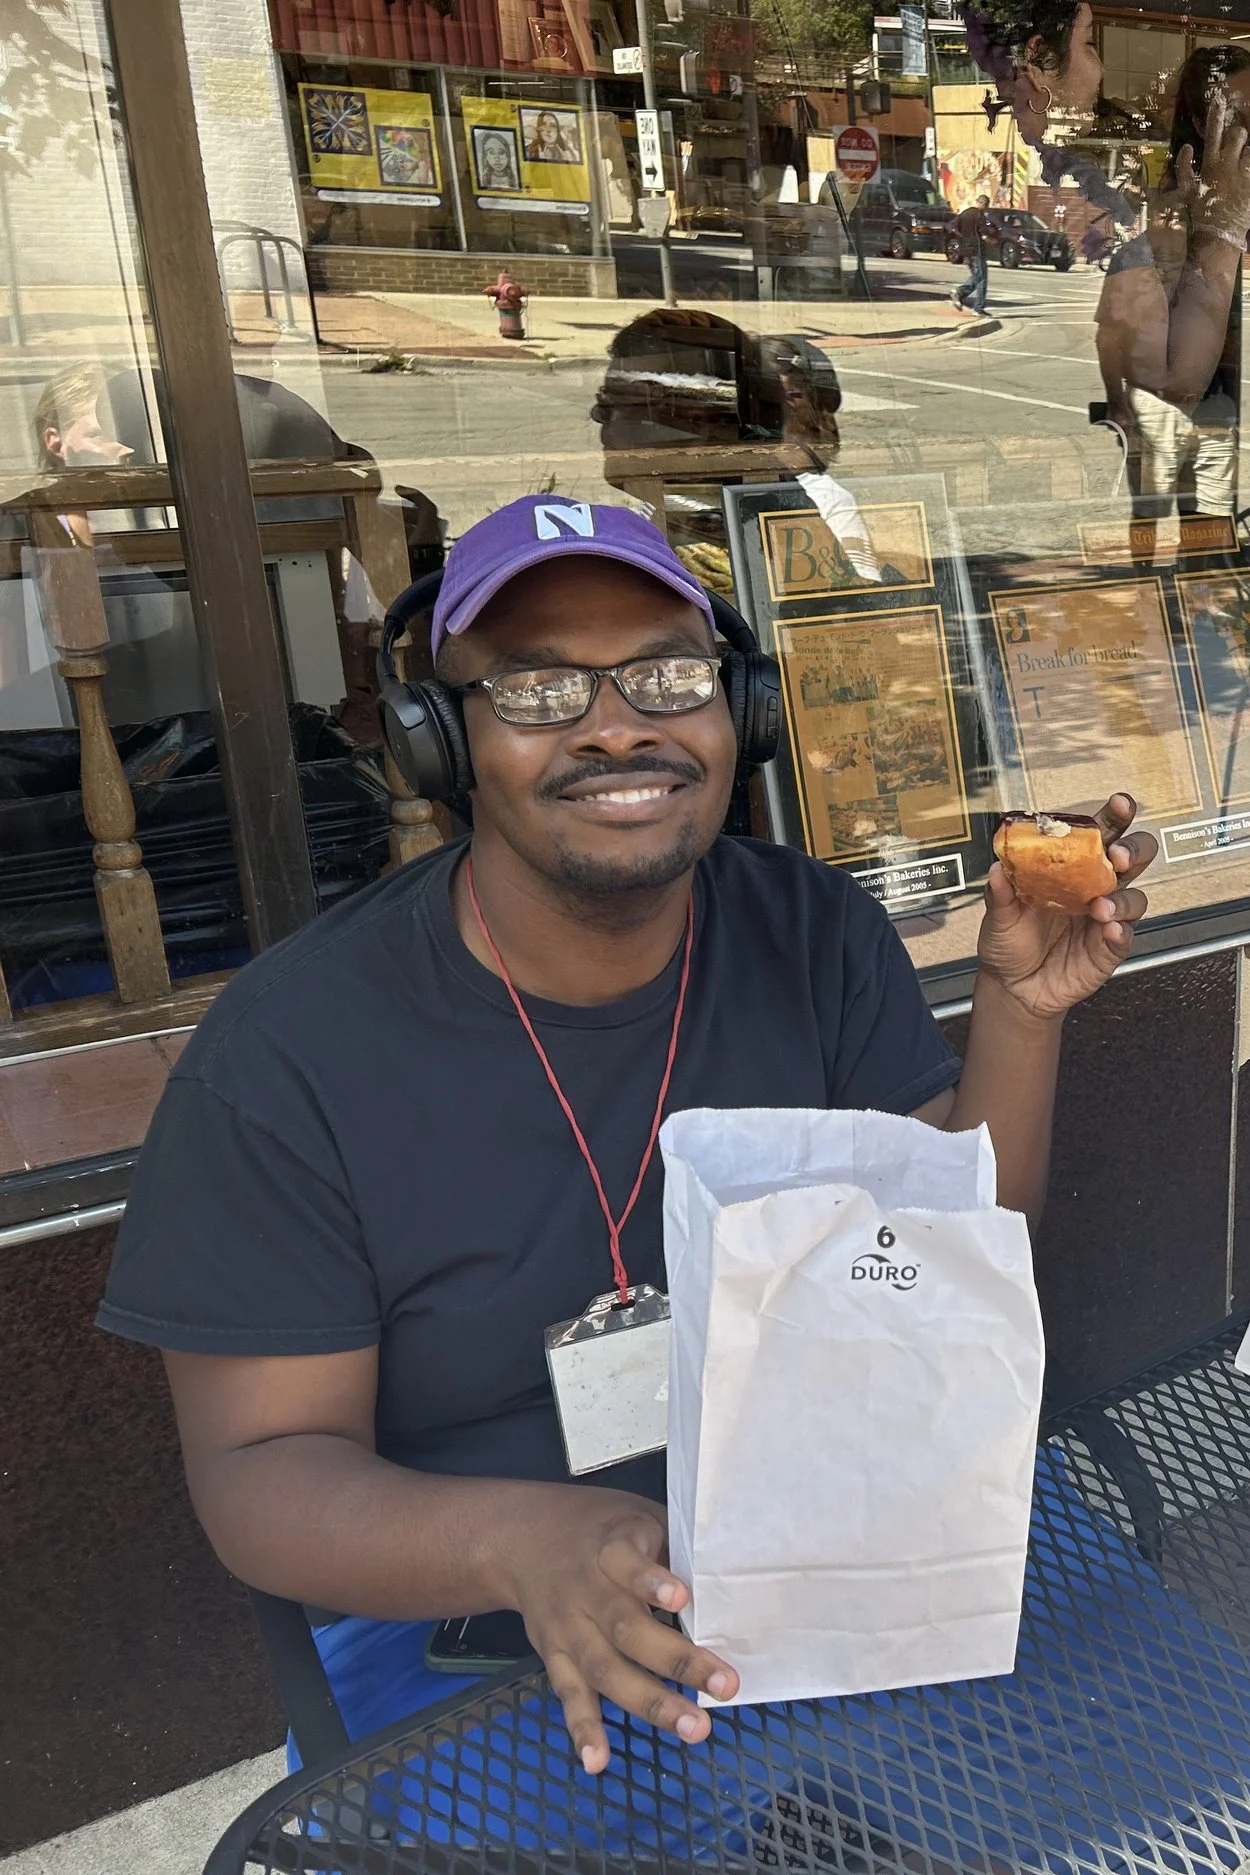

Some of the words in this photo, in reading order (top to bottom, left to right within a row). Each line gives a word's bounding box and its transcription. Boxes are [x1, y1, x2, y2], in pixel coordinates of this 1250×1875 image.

[534, 503, 594, 540] N
[1181, 526, 1229, 542] Magazine
[1016, 648, 1065, 673] Break
[1068, 647, 1090, 667] for
[1092, 640, 1139, 663] bread
[1173, 826, 1212, 842] Bennison's
[1212, 821, 1242, 835] Bakeries
[893, 867, 931, 881] Bakeries
[932, 864, 949, 875] Inc.
[888, 886, 911, 898] August
[911, 881, 928, 892] 2005
[876, 1225, 896, 1249] 6
[851, 1265, 918, 1281] DURO
